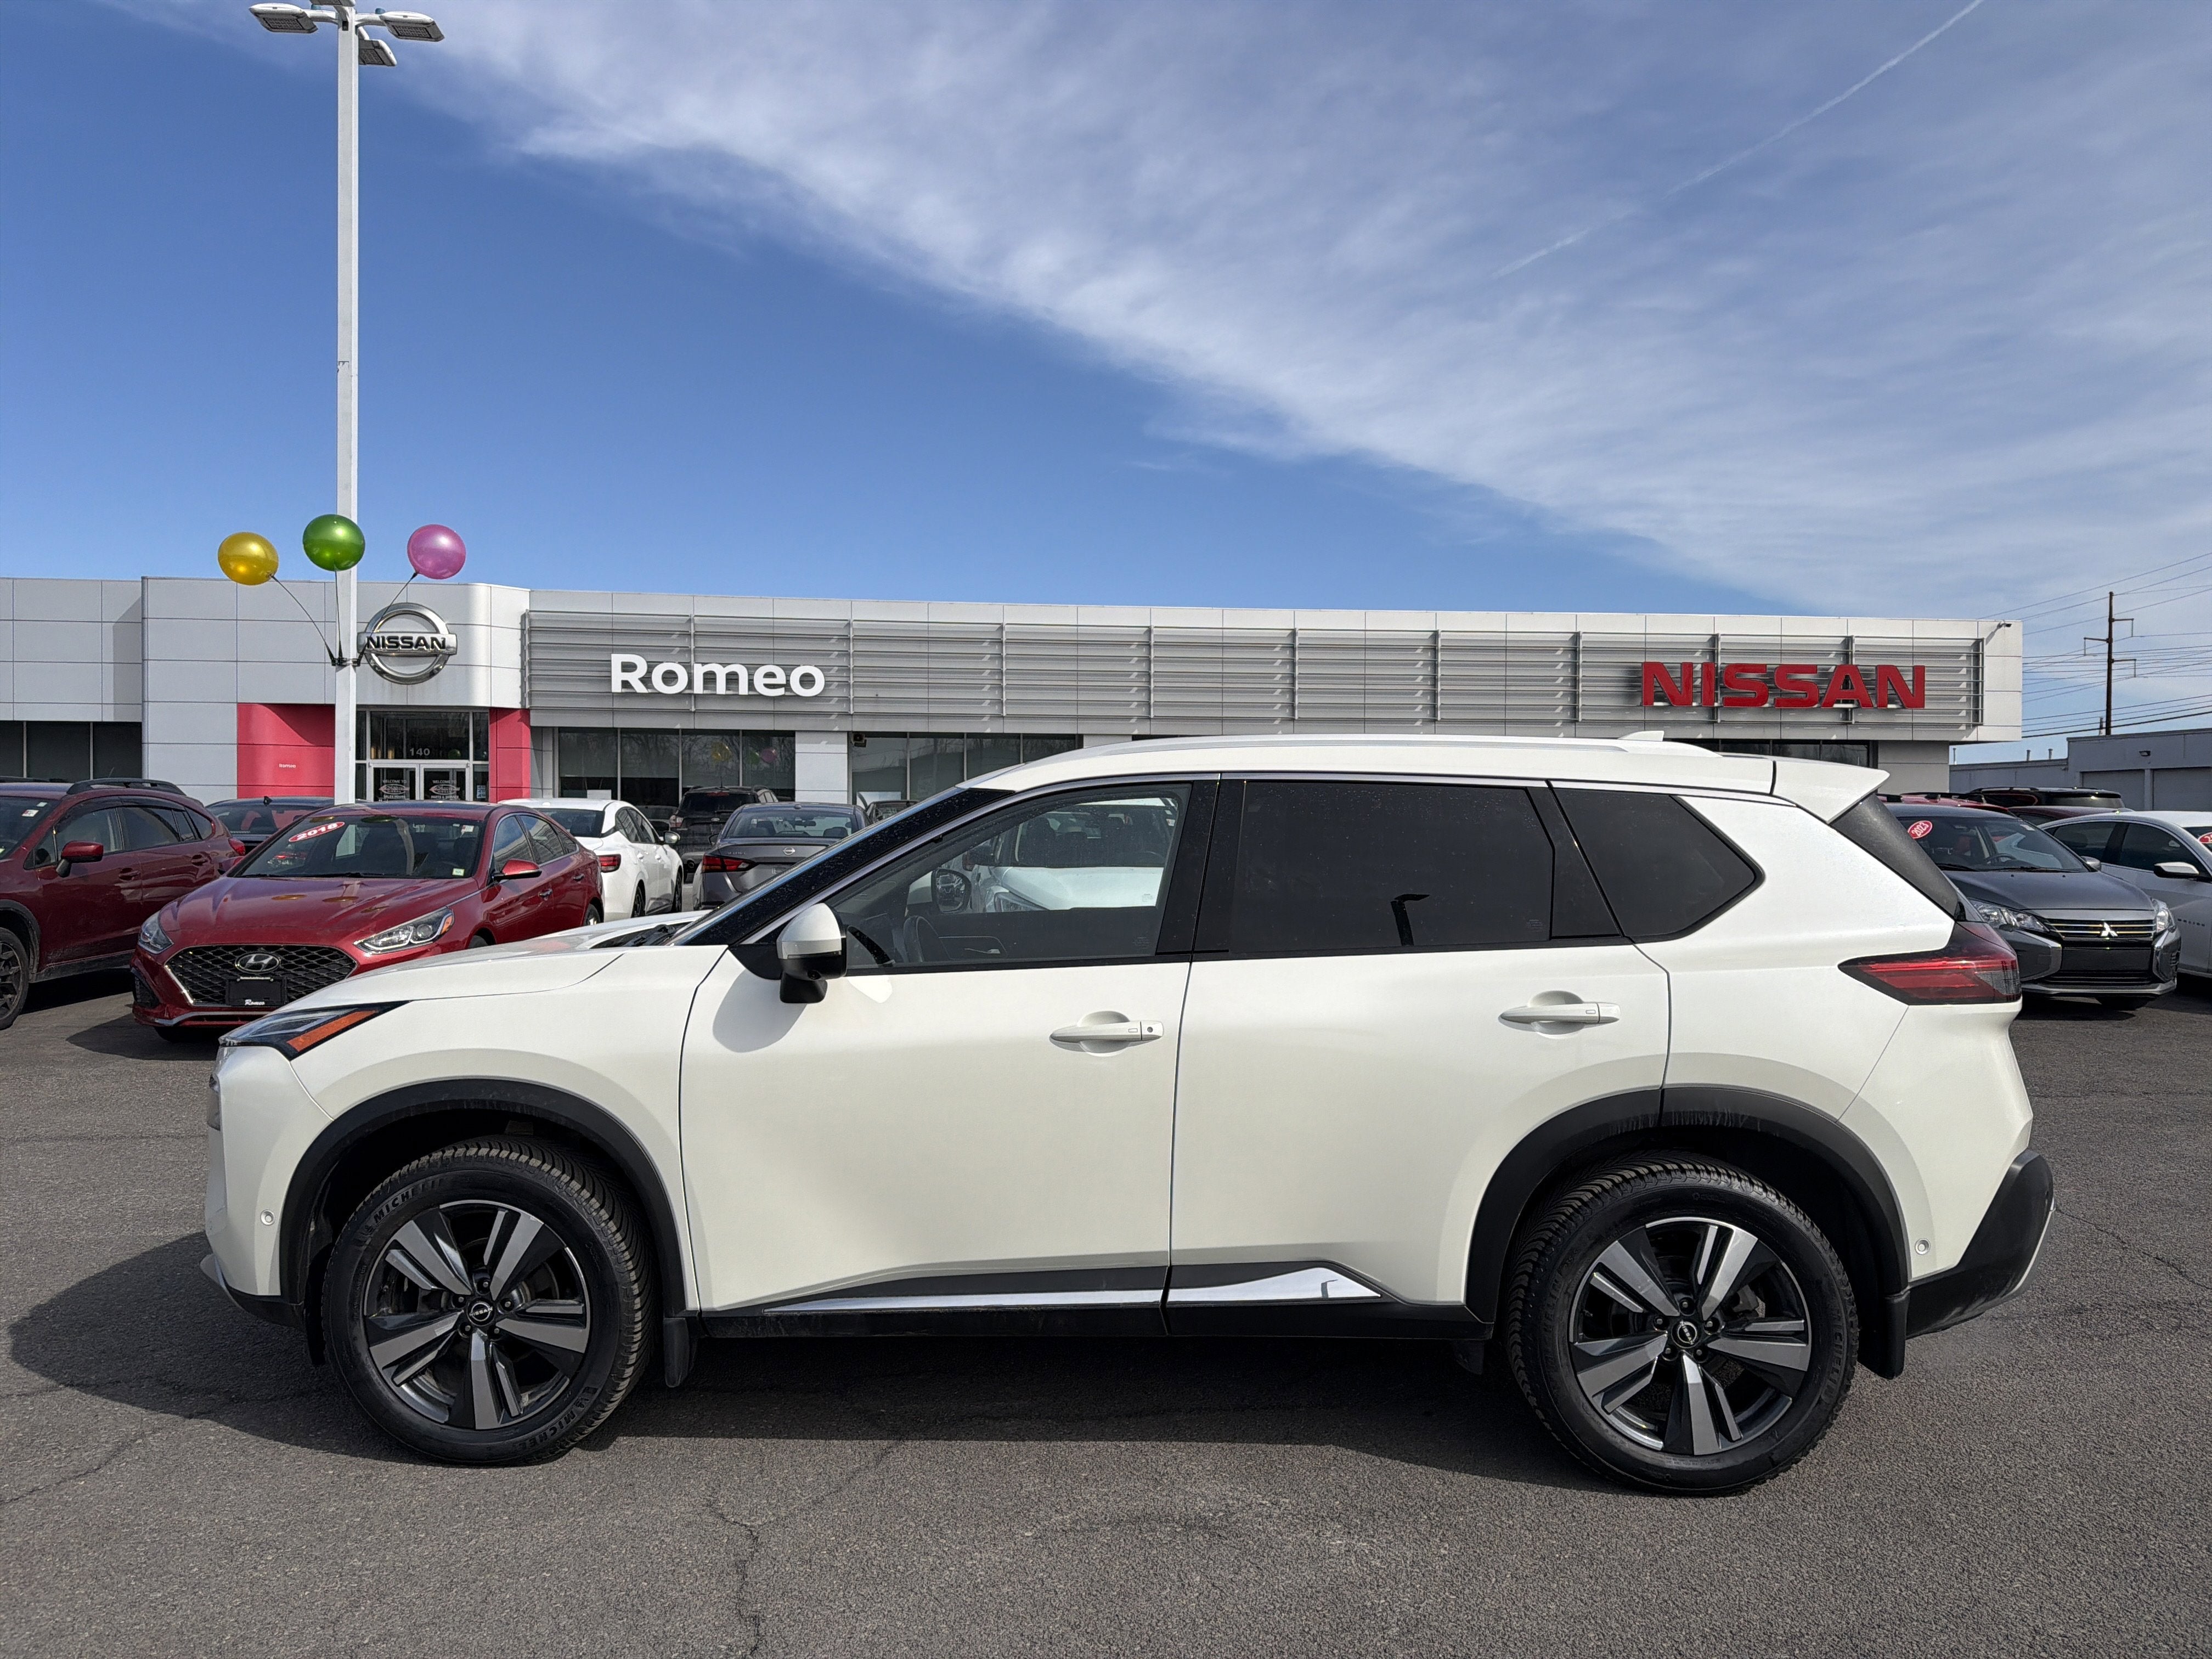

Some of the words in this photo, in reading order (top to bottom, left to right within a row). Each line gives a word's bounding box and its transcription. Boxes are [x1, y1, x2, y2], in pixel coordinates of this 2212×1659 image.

[365, 635, 446, 650] NISSAN
[611, 653, 825, 697] Romeo
[1642, 661, 1926, 709] NISSAN
[409, 748, 430, 756] 140
[296, 823, 338, 841] 2018
[1911, 822, 1929, 837] 2023
[469, 1306, 493, 1317] NISSAN
